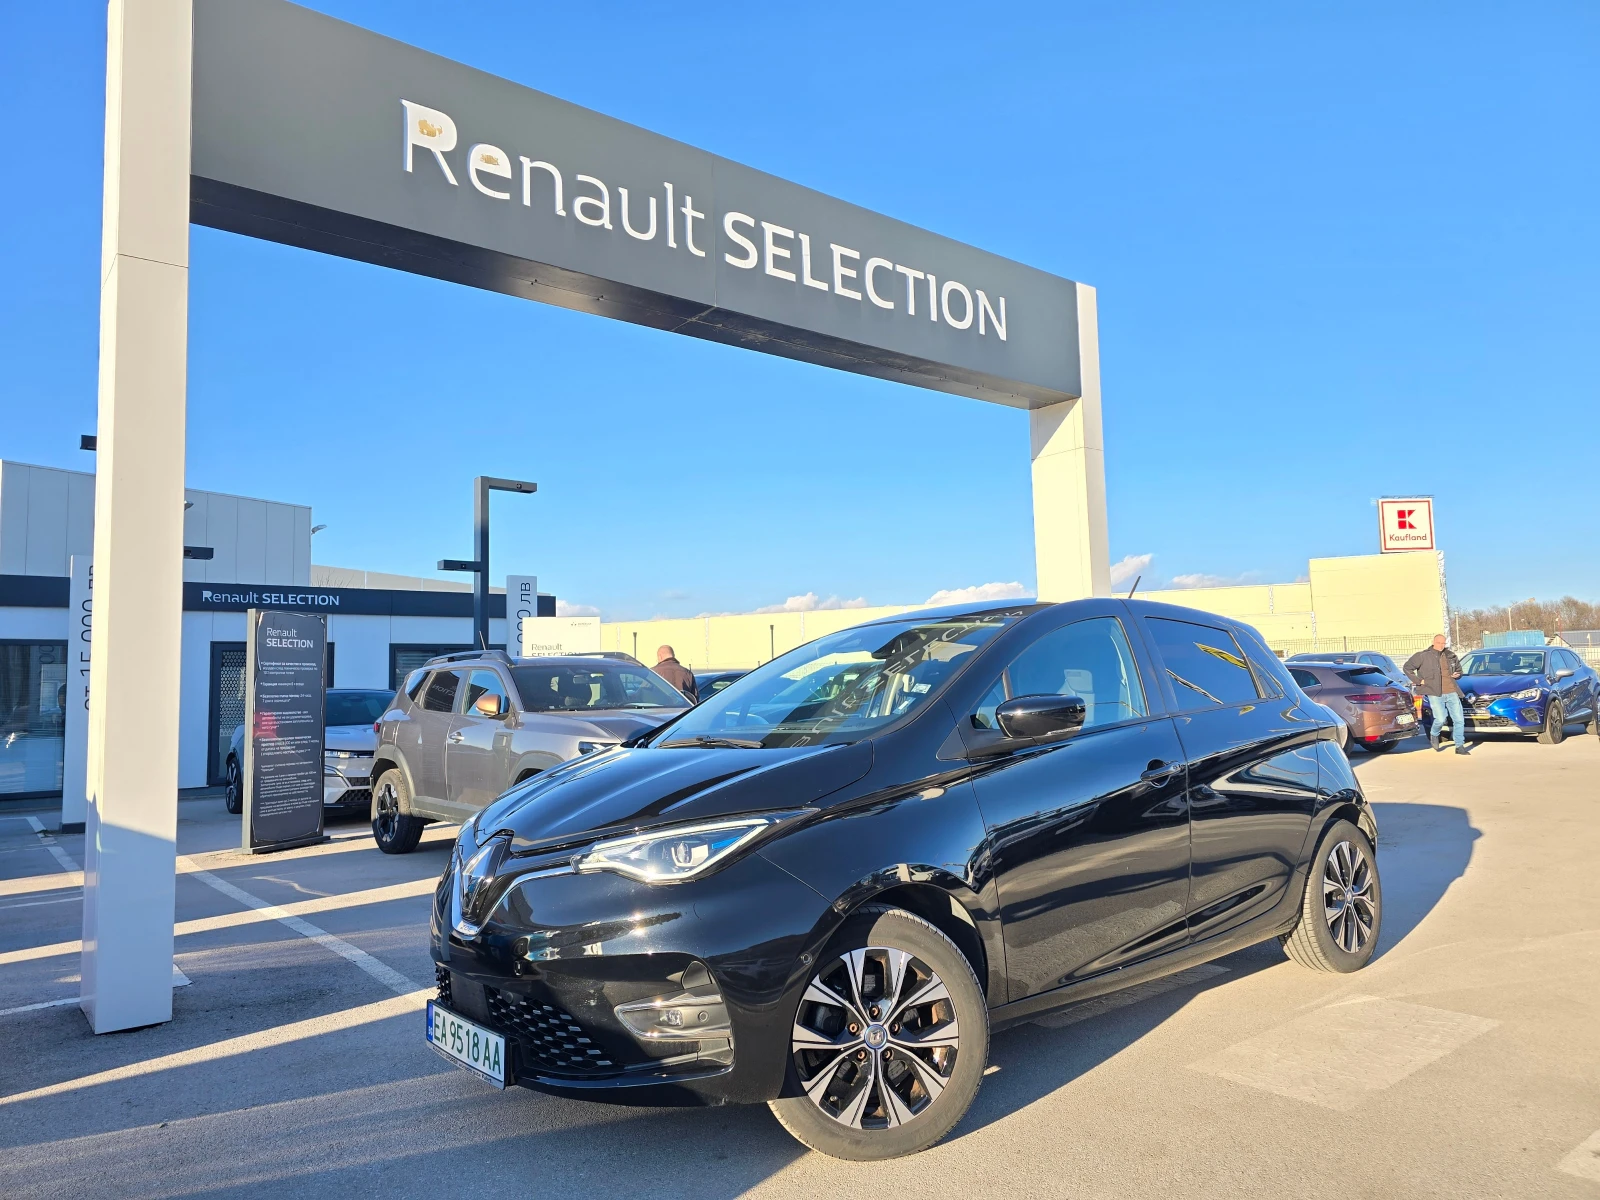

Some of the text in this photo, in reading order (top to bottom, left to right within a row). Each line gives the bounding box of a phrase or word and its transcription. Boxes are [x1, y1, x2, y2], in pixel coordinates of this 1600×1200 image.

[400, 98, 1007, 341] Renault SELECTION
[1389, 533, 1428, 541] Kaufland
[202, 590, 340, 606] Renault SELECTION
[266, 627, 298, 638] Renault
[266, 638, 314, 648] SELECTION
[531, 643, 563, 651] Renault
